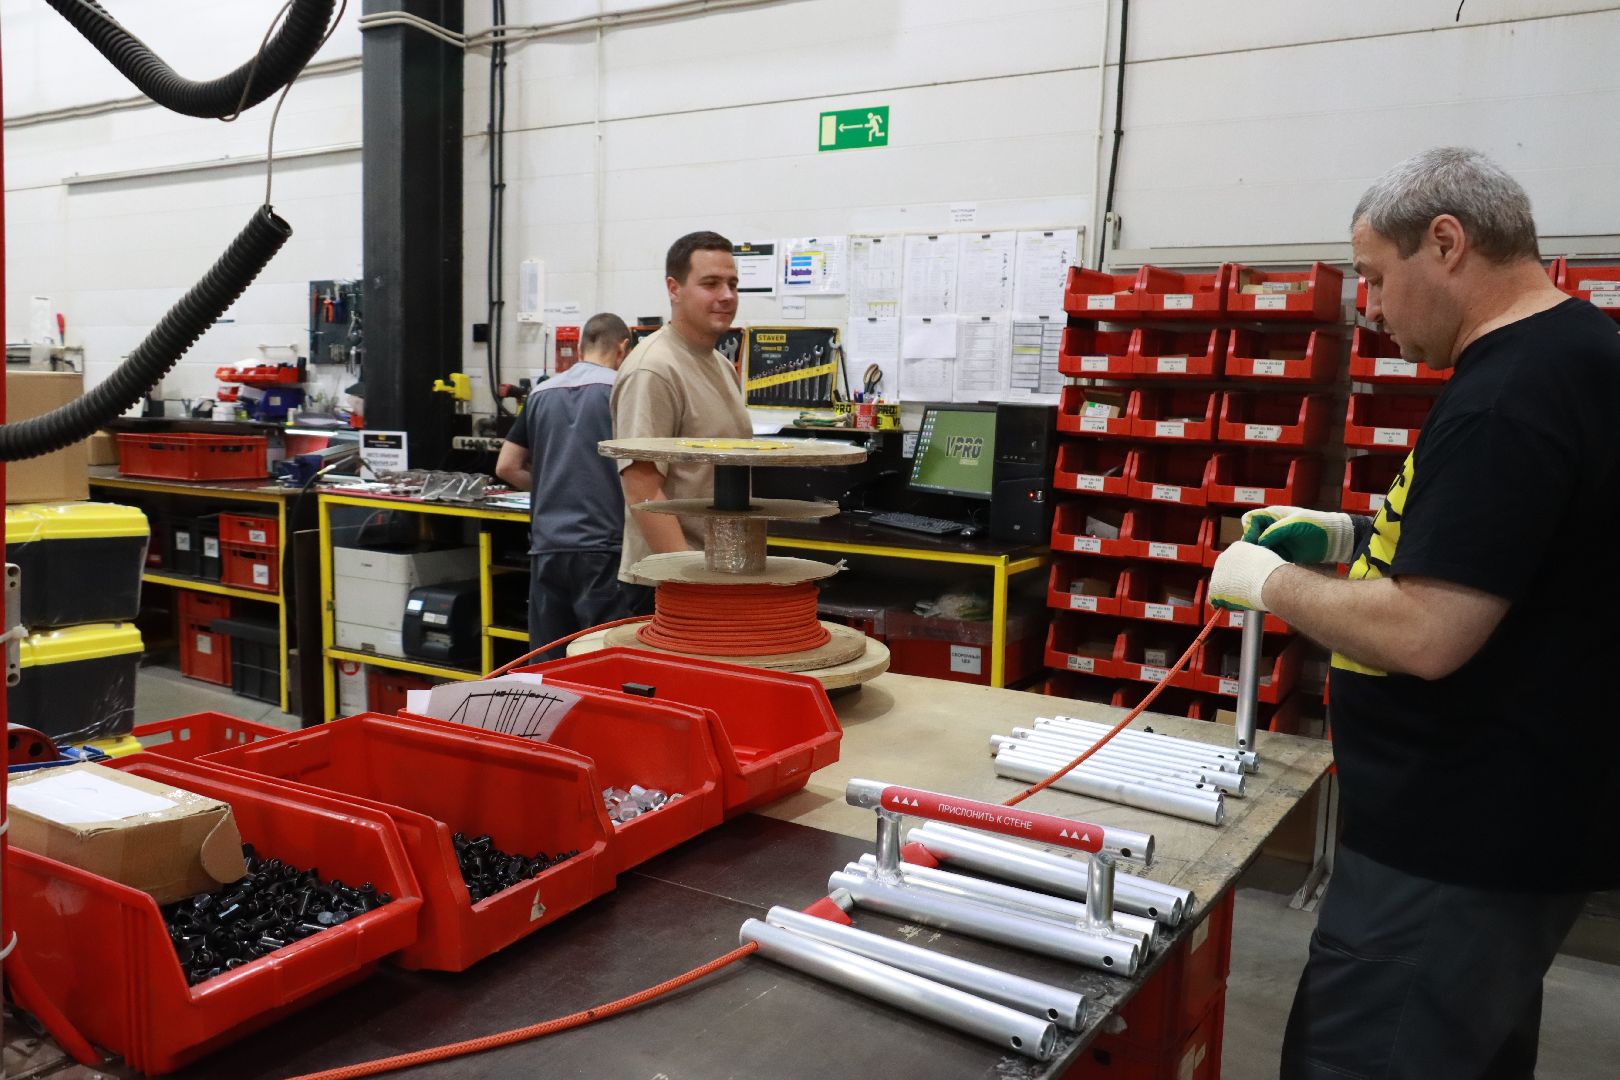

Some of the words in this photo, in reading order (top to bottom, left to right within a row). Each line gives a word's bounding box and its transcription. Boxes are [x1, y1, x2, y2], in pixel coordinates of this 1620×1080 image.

[757, 334, 785, 342] STAVER
[945, 436, 984, 459] VPRO
[937, 803, 994, 822] ПРИСЛОНИТЬ
[996, 814, 1002, 824] К
[1003, 816, 1033, 830] СТЕНЕ
